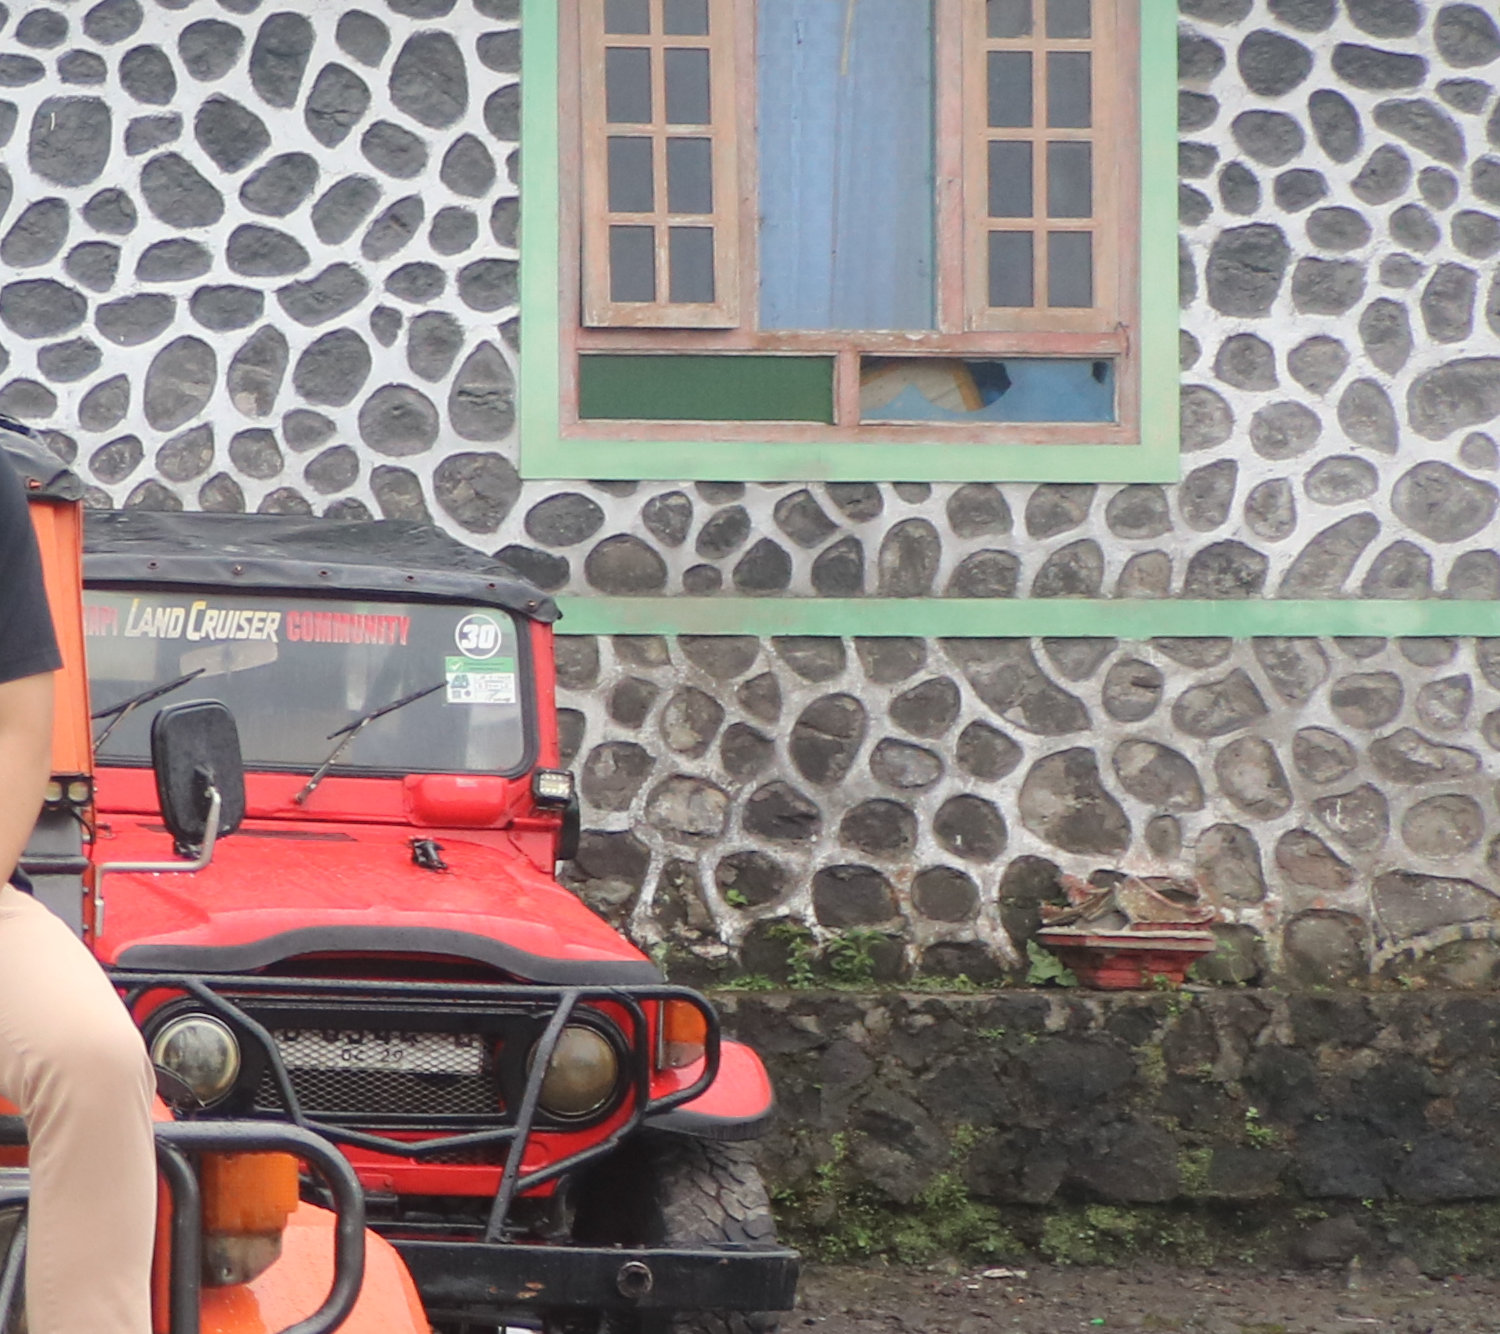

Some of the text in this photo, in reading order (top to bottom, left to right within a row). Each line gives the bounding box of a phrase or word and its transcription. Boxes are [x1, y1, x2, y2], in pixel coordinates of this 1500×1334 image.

[124, 598, 181, 639] LAND
[186, 600, 281, 643] CRUISER
[285, 610, 411, 646] COMMUNITY
[461, 624, 496, 649] 30
